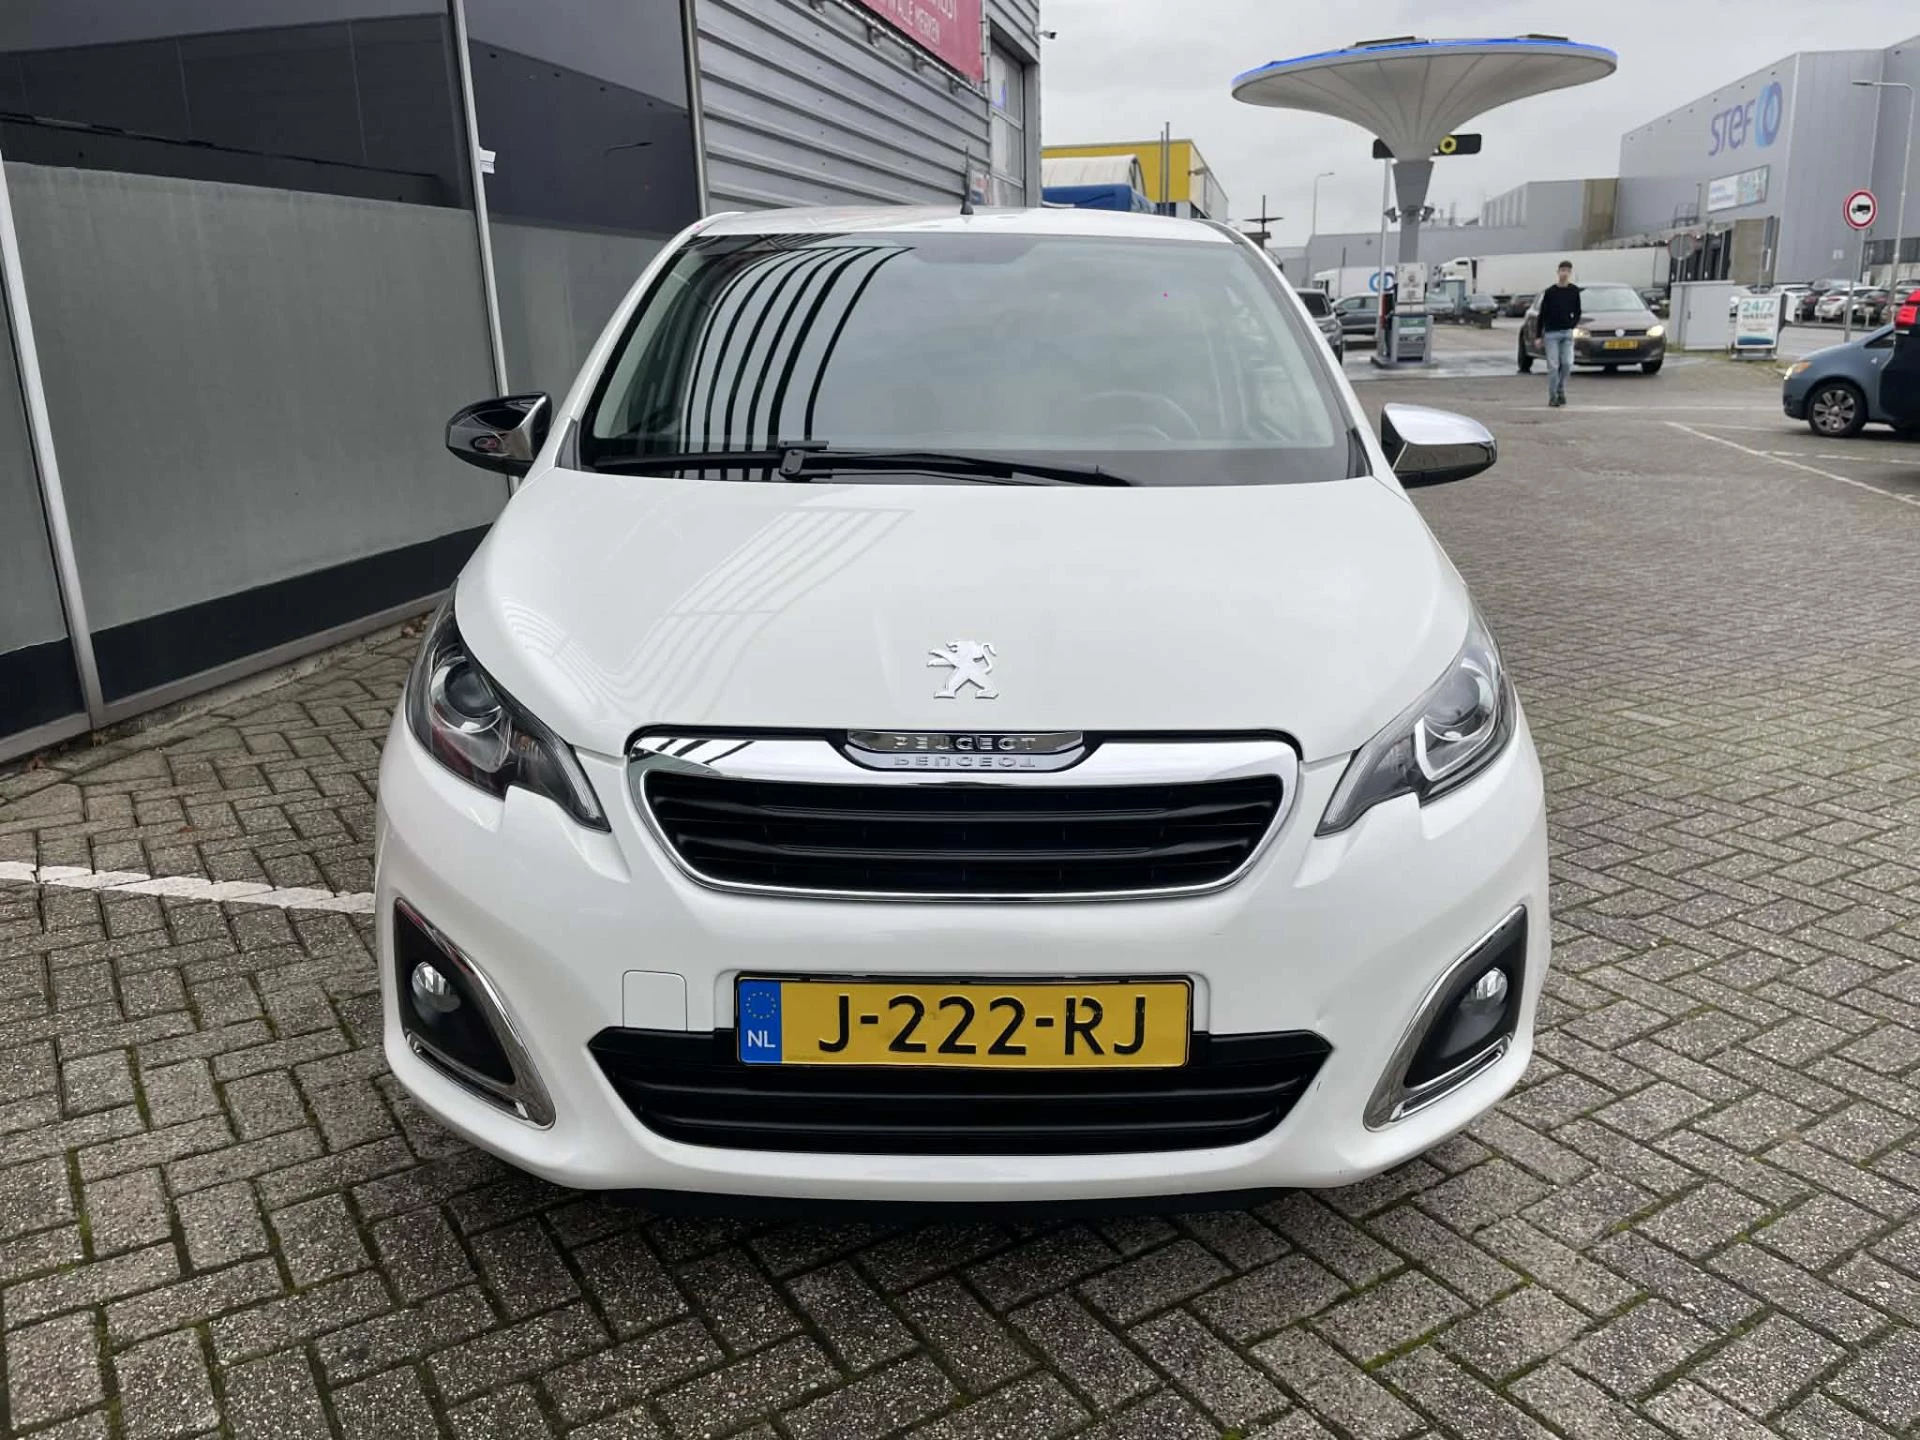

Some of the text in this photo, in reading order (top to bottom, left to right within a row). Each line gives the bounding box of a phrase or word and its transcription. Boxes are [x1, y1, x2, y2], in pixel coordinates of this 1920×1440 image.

[893, 735, 1036, 752] PEUGEOT
[817, 993, 1147, 1057] J-222-RJ
[746, 1029, 777, 1049] NL
